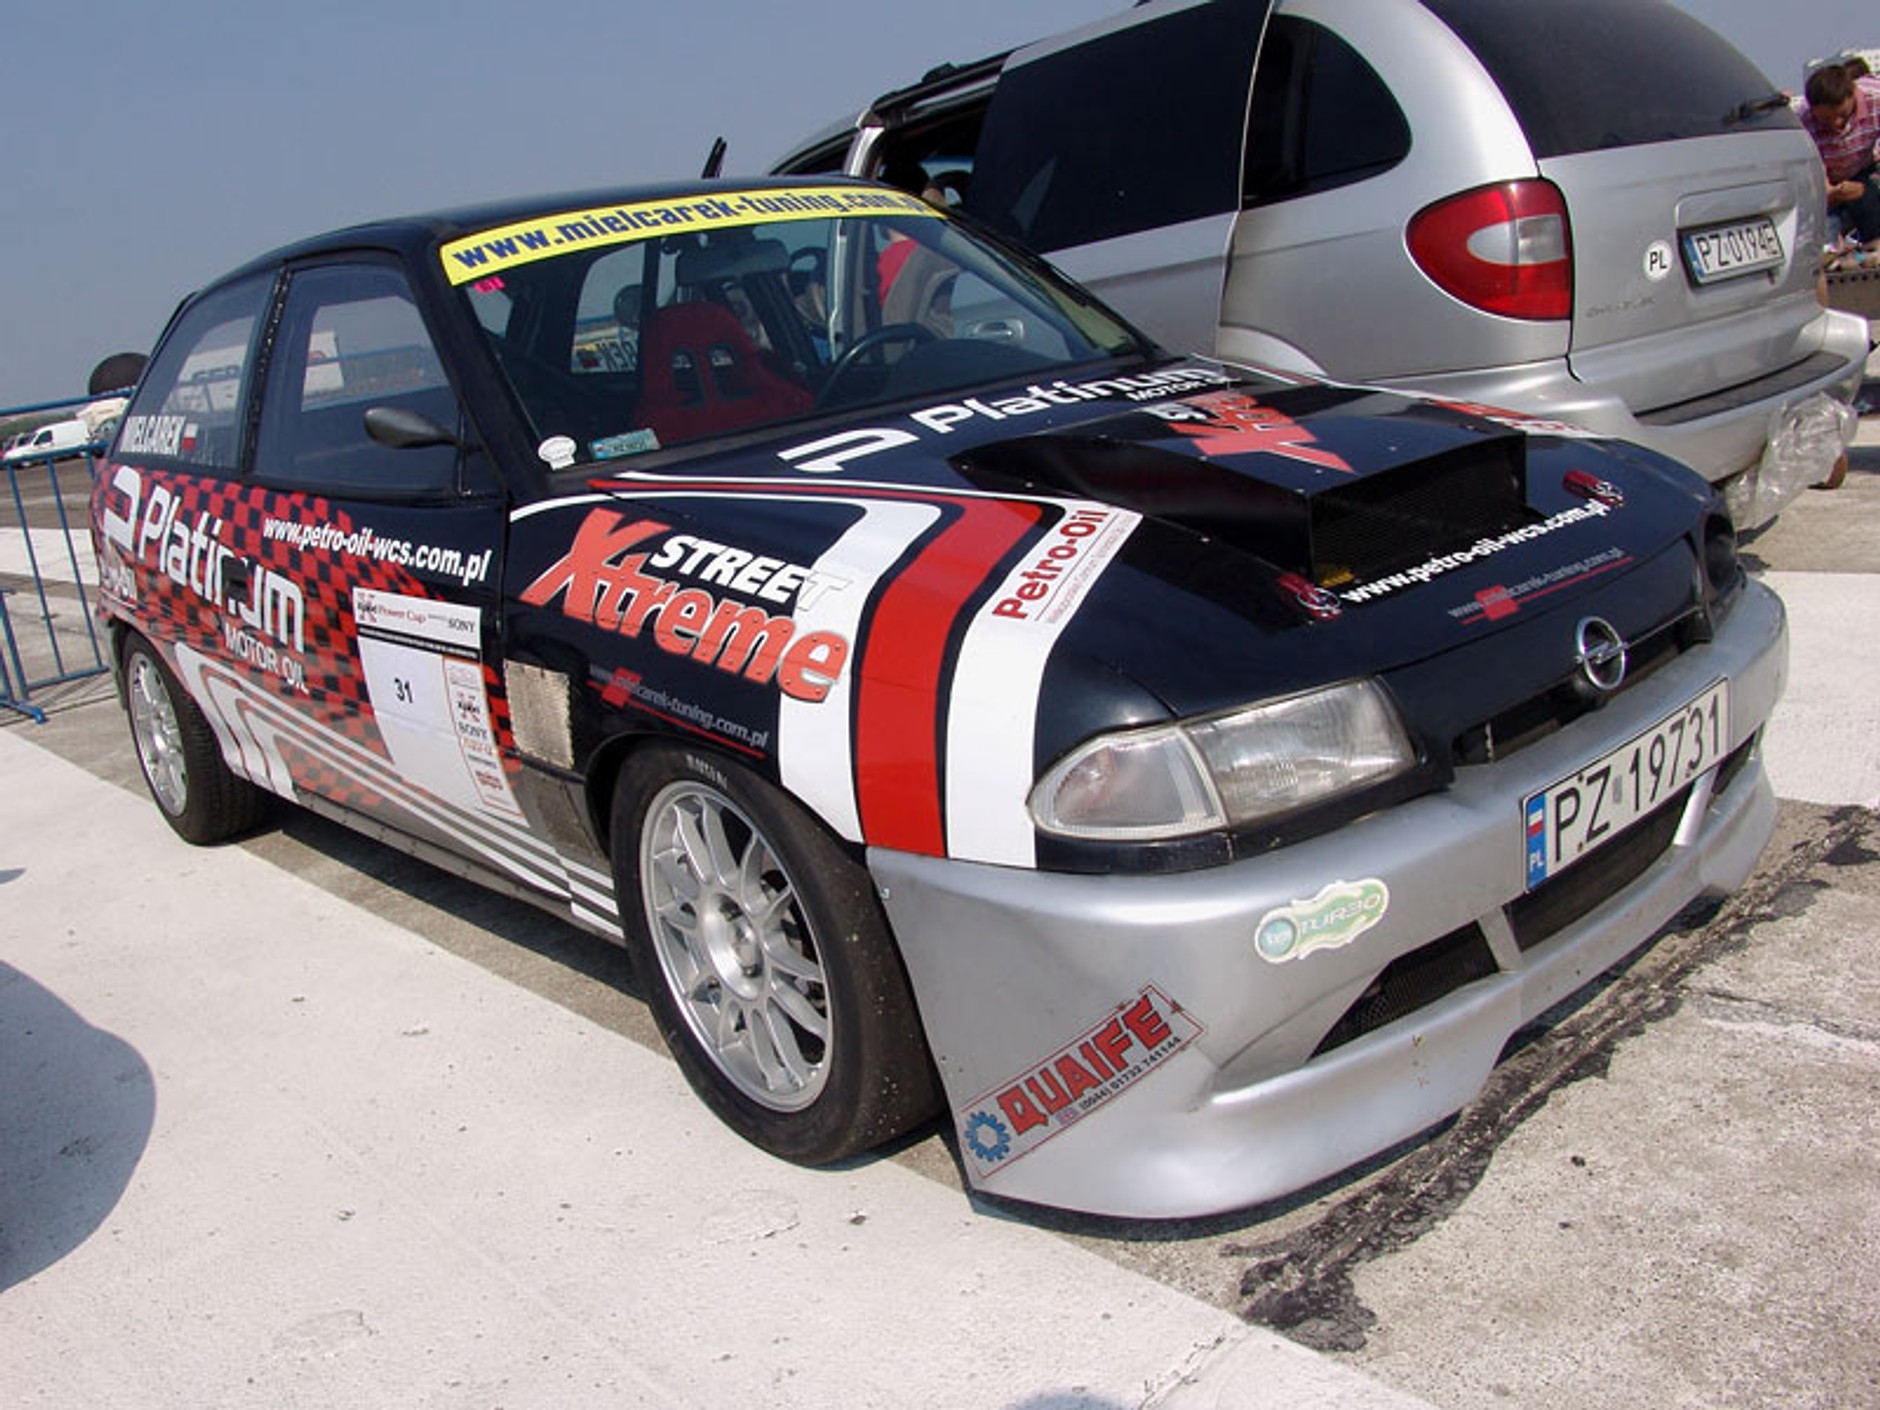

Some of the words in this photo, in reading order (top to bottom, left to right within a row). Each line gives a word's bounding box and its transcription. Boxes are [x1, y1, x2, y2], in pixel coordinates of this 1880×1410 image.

[1649, 250, 1668, 271] PL
[1697, 233, 1729, 271] PZ
[909, 368, 1220, 434] Platinum
[1125, 381, 1206, 401] MOTOR
[263, 517, 493, 587] www.petro-oil-wcs.com.pl
[649, 535, 853, 612] STREET
[992, 509, 1110, 620] Petro-Oil
[519, 507, 850, 703] Xtreme
[224, 622, 280, 675] MOTOR
[281, 656, 311, 694] OIL
[395, 677, 413, 704] 31
[1556, 764, 1611, 863] PZ
[1628, 692, 1720, 813] 19731
[1529, 853, 1544, 872] PL
[996, 993, 1173, 1136] QUAIFE
